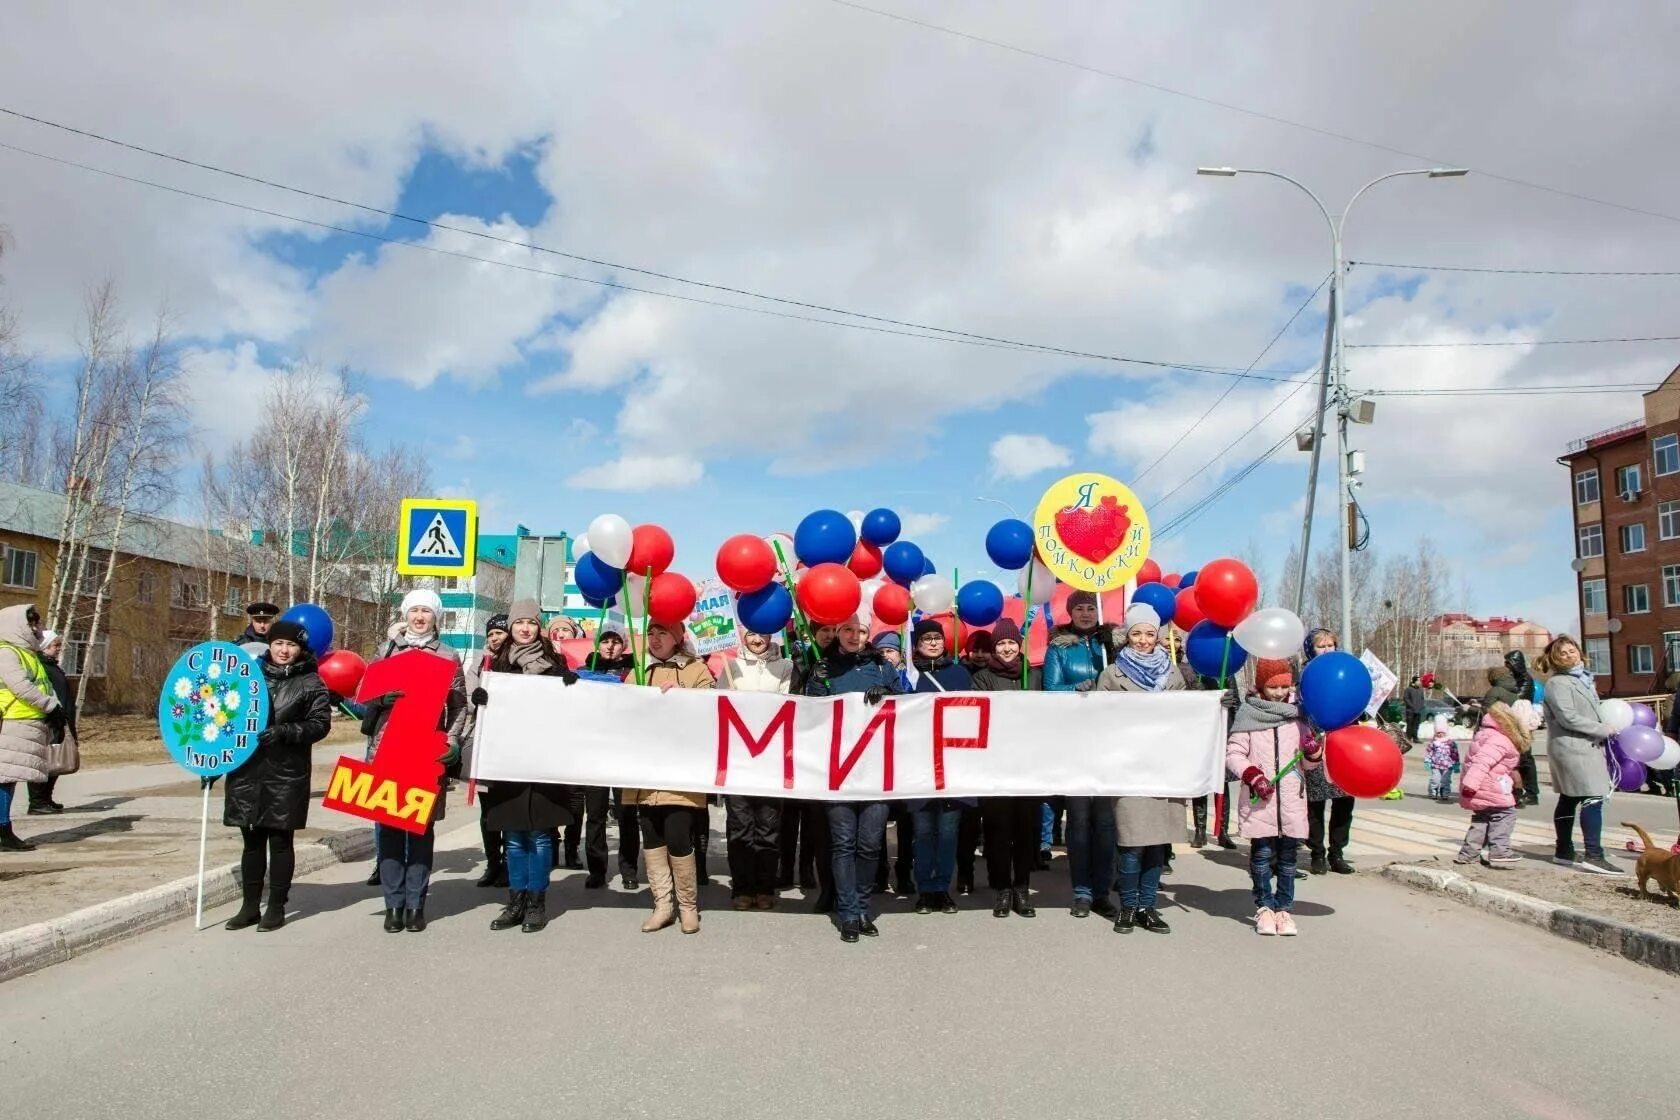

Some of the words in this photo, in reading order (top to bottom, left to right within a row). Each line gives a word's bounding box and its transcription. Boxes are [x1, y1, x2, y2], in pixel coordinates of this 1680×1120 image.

[1063, 482, 1099, 513] Я
[1039, 523, 1144, 587] ПОЙКОВСКИЙ
[695, 594, 730, 613] МАЯ
[188, 651, 202, 671] С
[354, 647, 458, 786] 1
[714, 695, 991, 791] МИР
[327, 766, 436, 825] МАЯ
